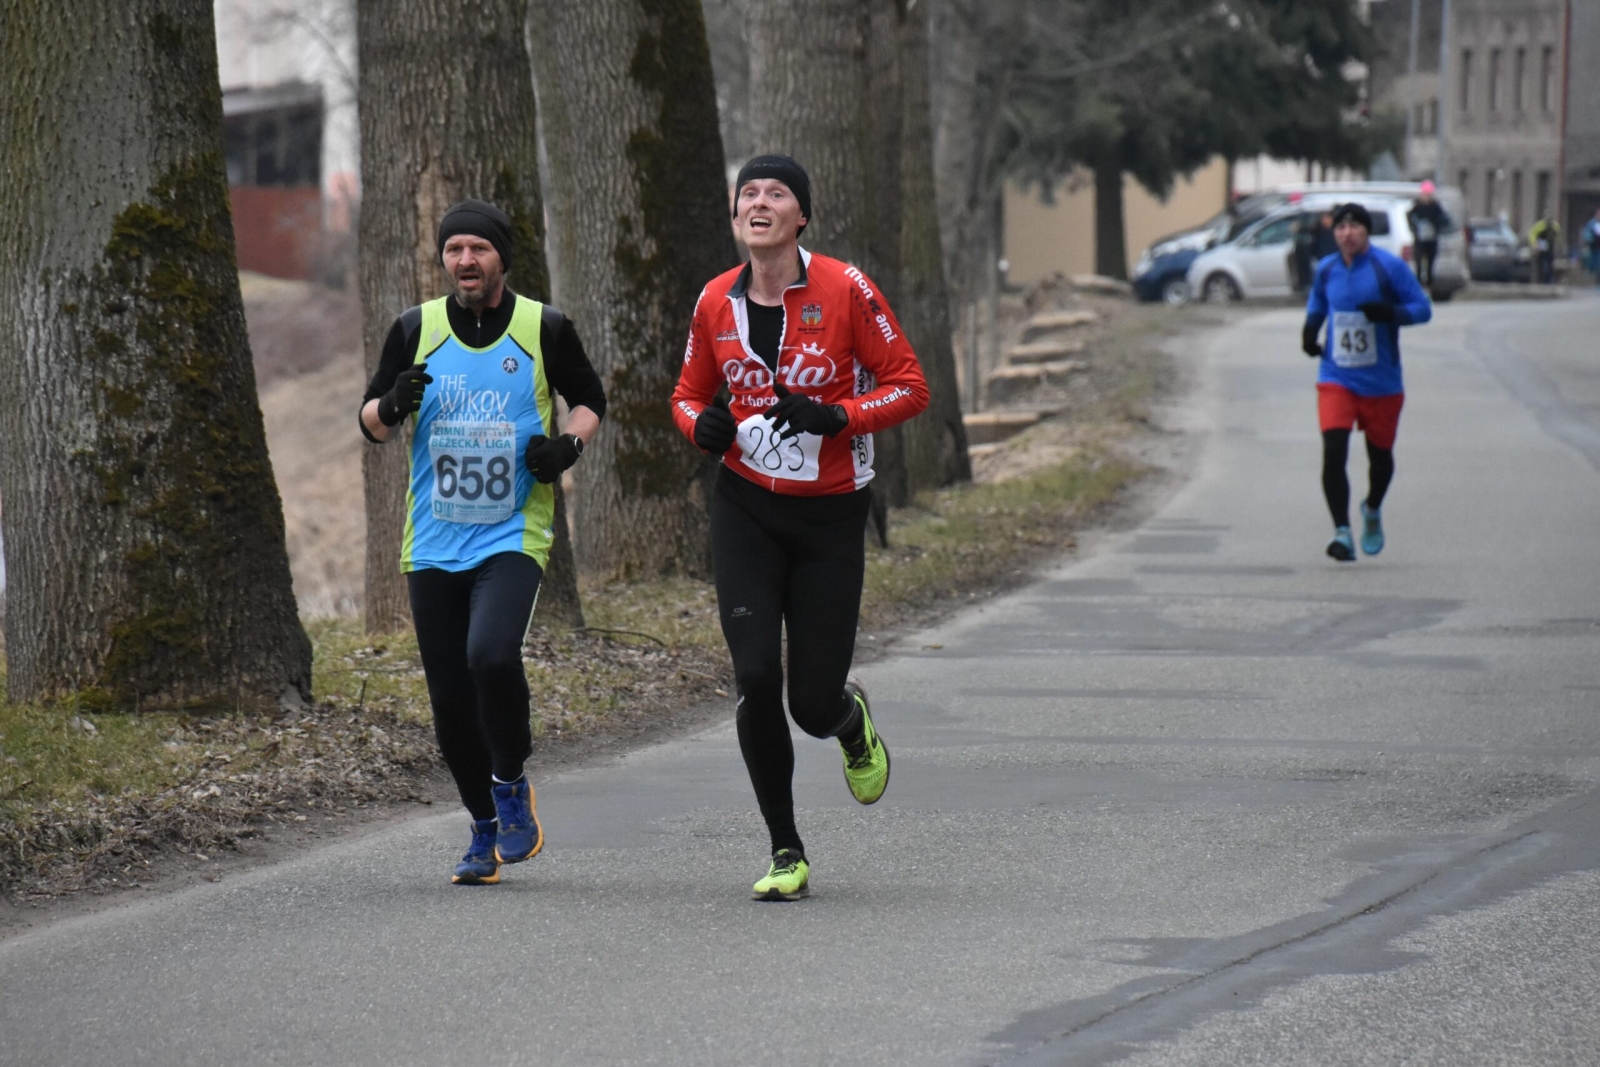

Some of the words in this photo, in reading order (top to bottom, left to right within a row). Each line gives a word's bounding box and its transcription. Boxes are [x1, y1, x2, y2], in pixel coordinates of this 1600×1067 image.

[844, 266, 874, 300] mon
[1340, 329, 1368, 353] 43
[440, 374, 467, 391] THE
[722, 352, 836, 390] Carla
[438, 390, 511, 413] WIKOV
[434, 425, 465, 436] ZIMNÍ
[431, 437, 480, 449] BĚŽECKÁ
[485, 440, 512, 449] LIGA
[748, 426, 804, 472] 283
[436, 454, 511, 501] 658
